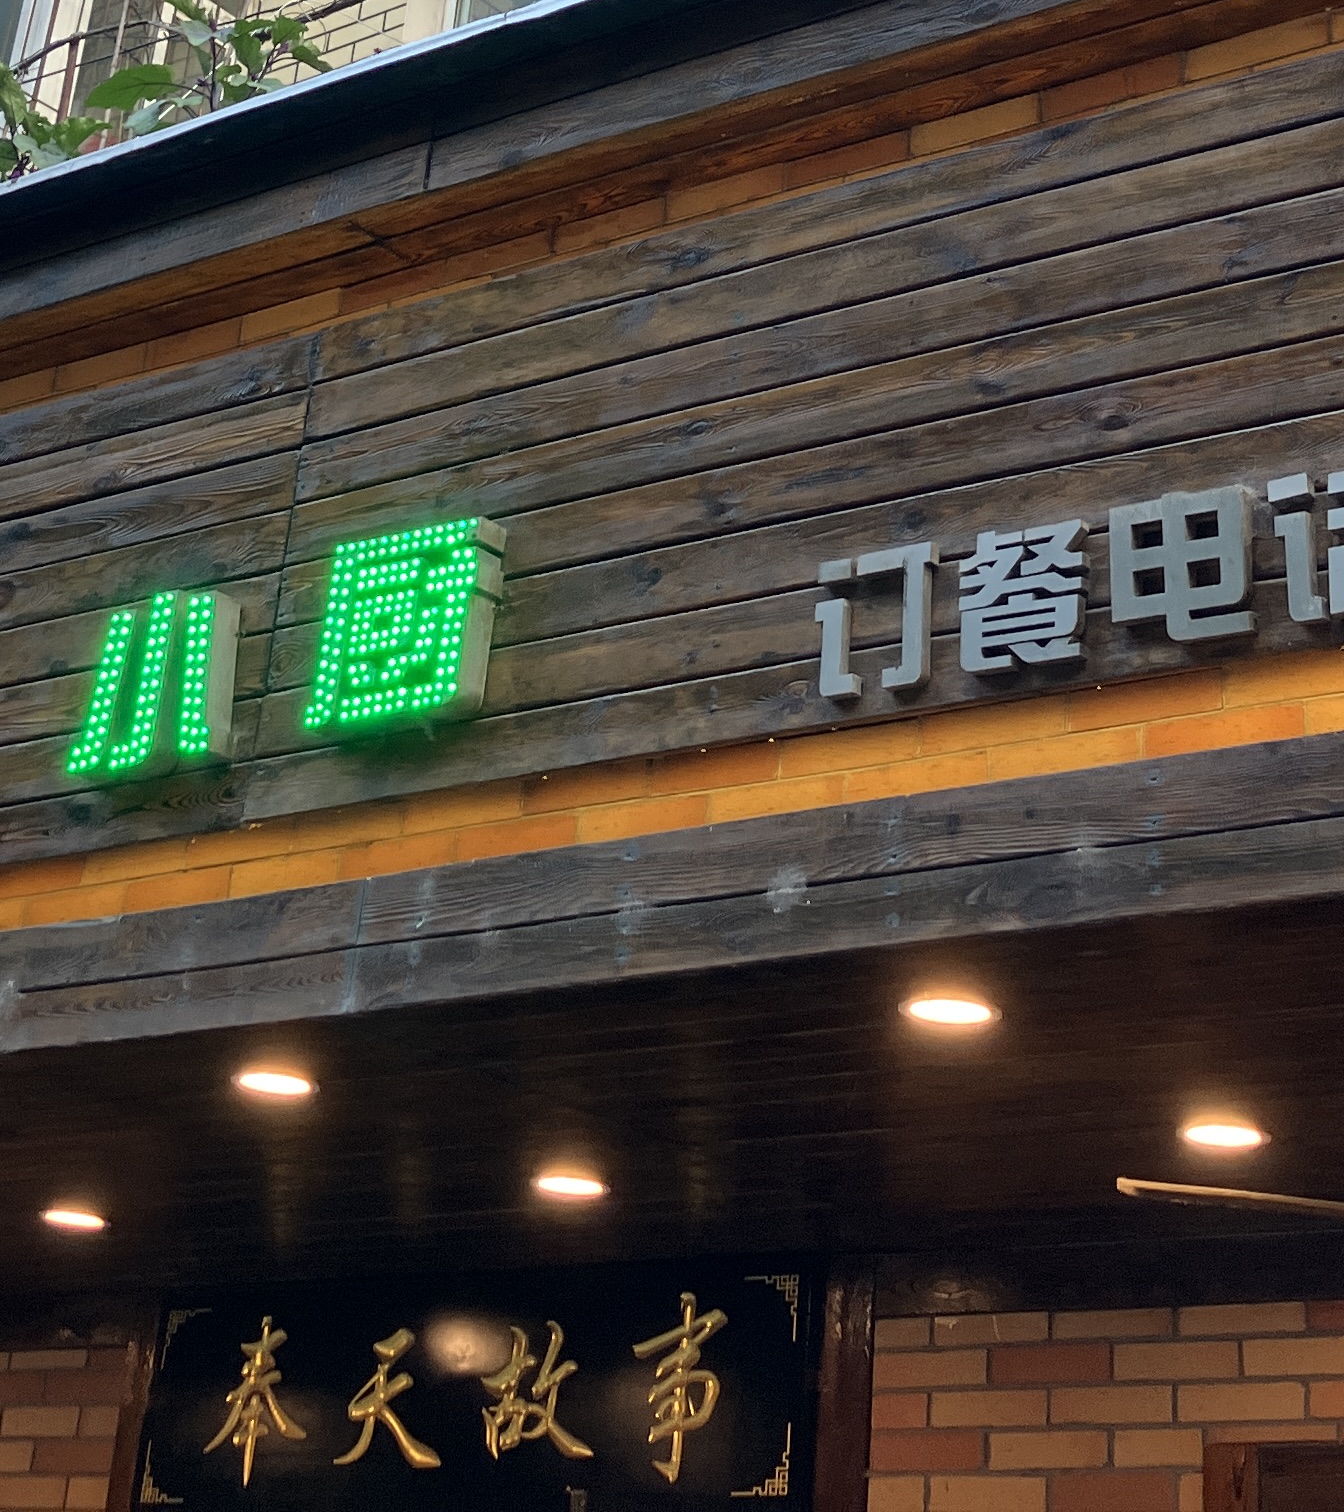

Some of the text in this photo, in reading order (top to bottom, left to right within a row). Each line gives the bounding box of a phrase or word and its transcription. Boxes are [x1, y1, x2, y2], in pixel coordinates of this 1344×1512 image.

[66, 516, 488, 776] 小厨
[203, 1291, 730, 1488] 奉天故事
